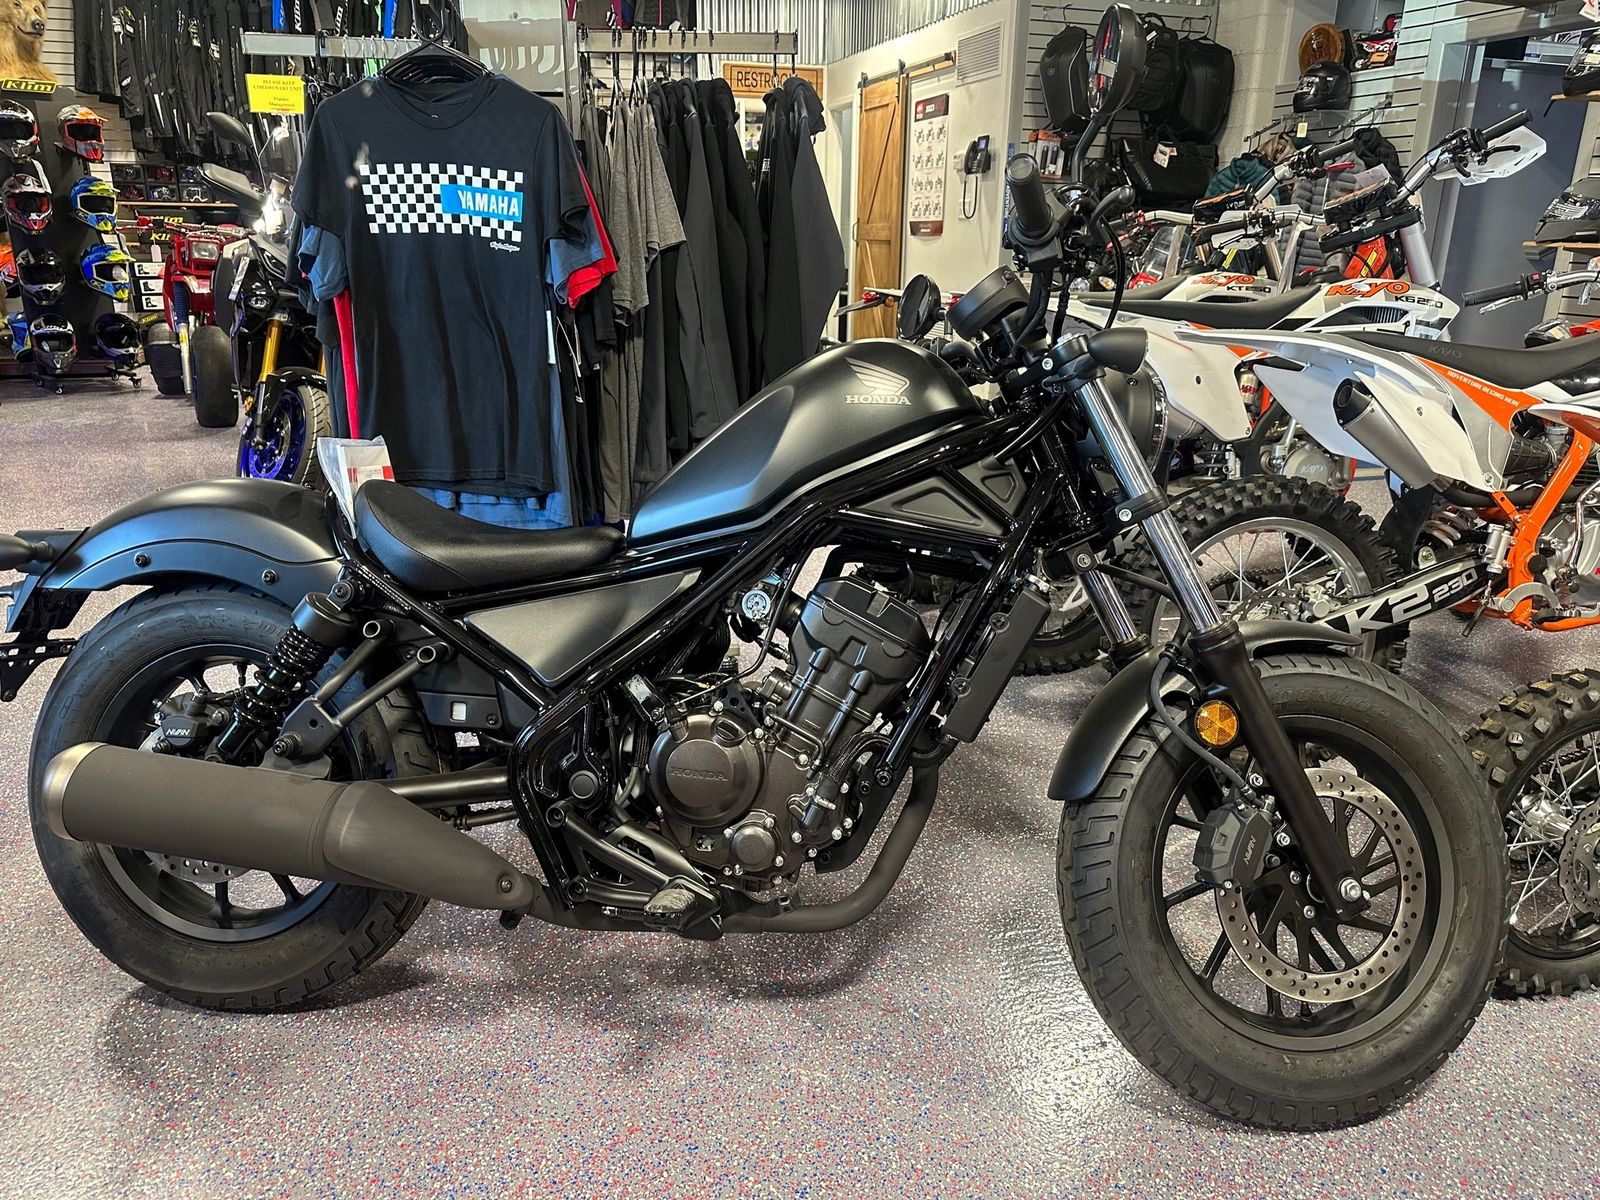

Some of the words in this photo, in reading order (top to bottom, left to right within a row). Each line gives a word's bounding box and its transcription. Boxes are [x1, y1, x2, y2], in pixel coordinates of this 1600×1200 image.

[456, 190, 519, 217] YAMAHA
[1428, 344, 1462, 359] KAYO
[845, 394, 912, 405] HONDA
[1344, 583, 1432, 635] K2
[1431, 567, 1479, 603] 230
[669, 766, 729, 782] HONDA
